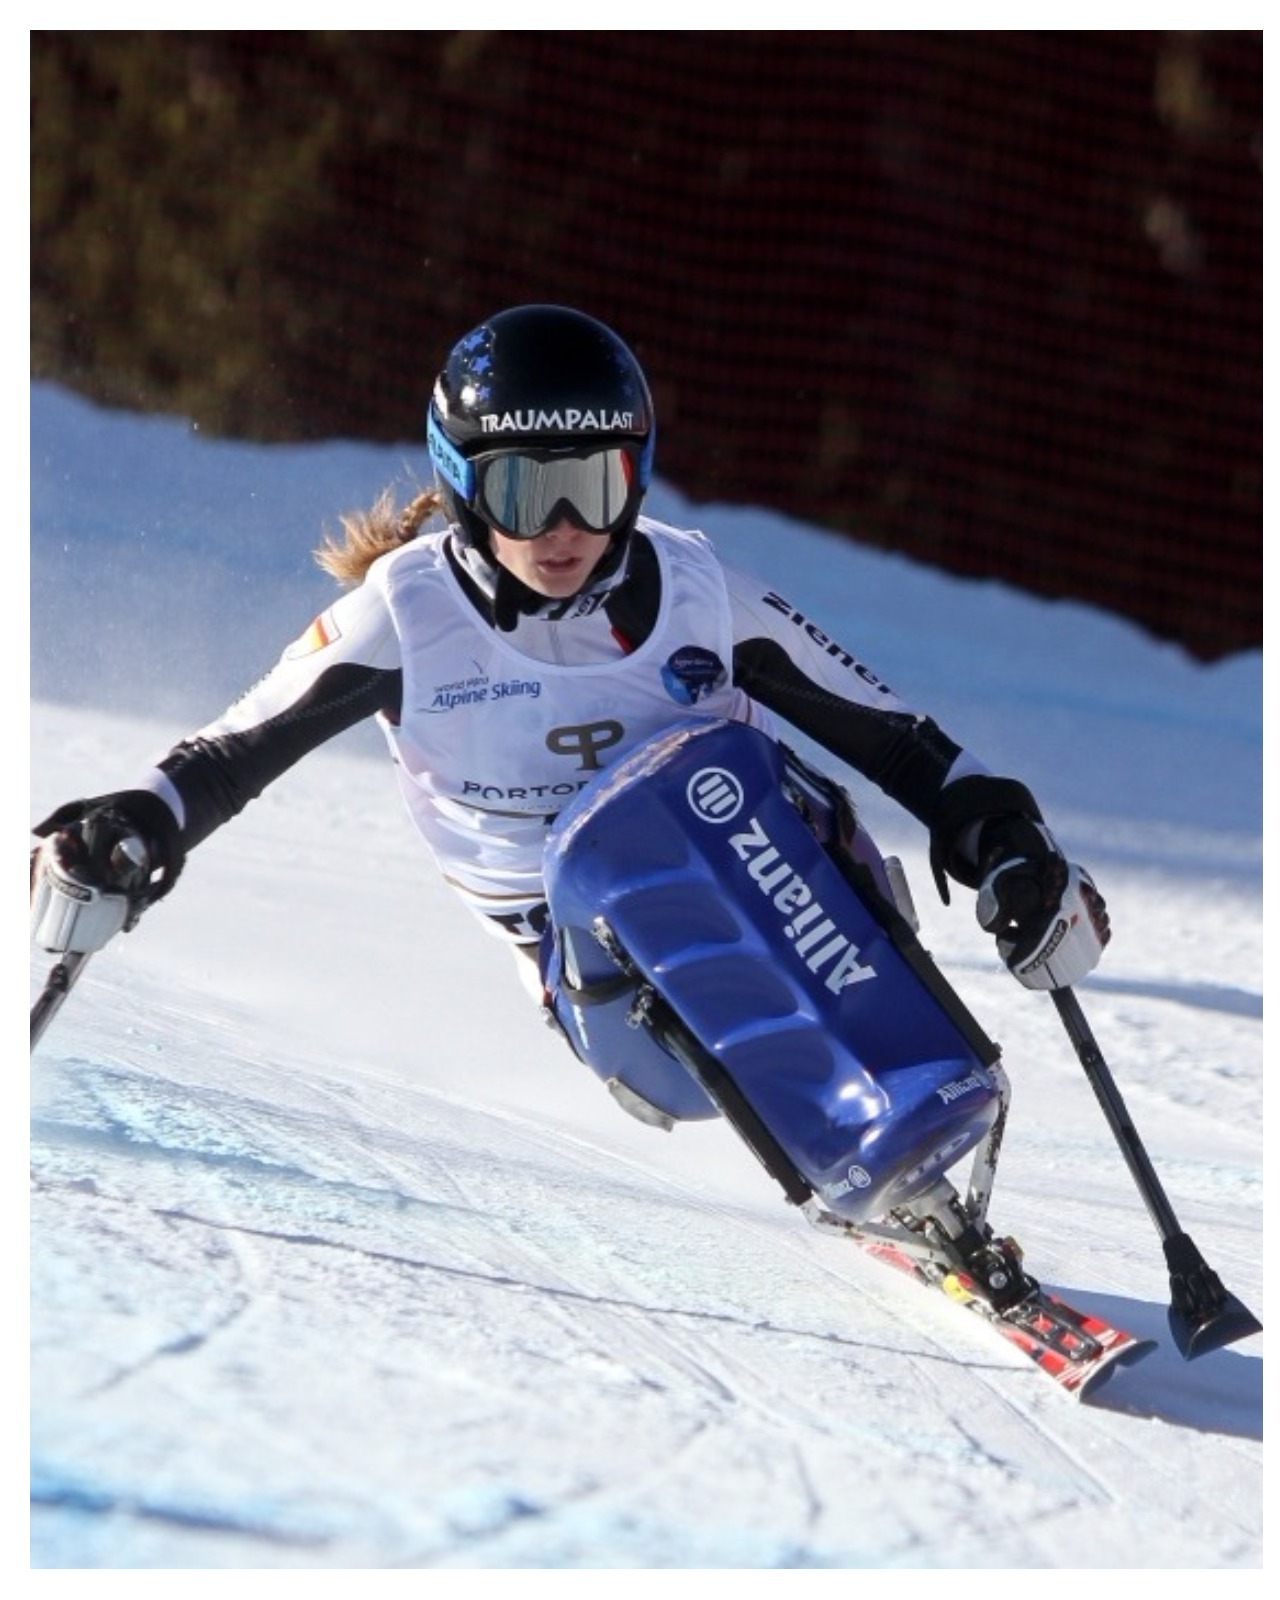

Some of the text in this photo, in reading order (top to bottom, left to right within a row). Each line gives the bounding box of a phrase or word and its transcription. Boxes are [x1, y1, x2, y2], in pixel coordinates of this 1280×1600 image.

[480, 409, 633, 432] TRAUMPALAST
[432, 680, 541, 709] Alpine Skiing
[728, 817, 877, 996] Allianz
